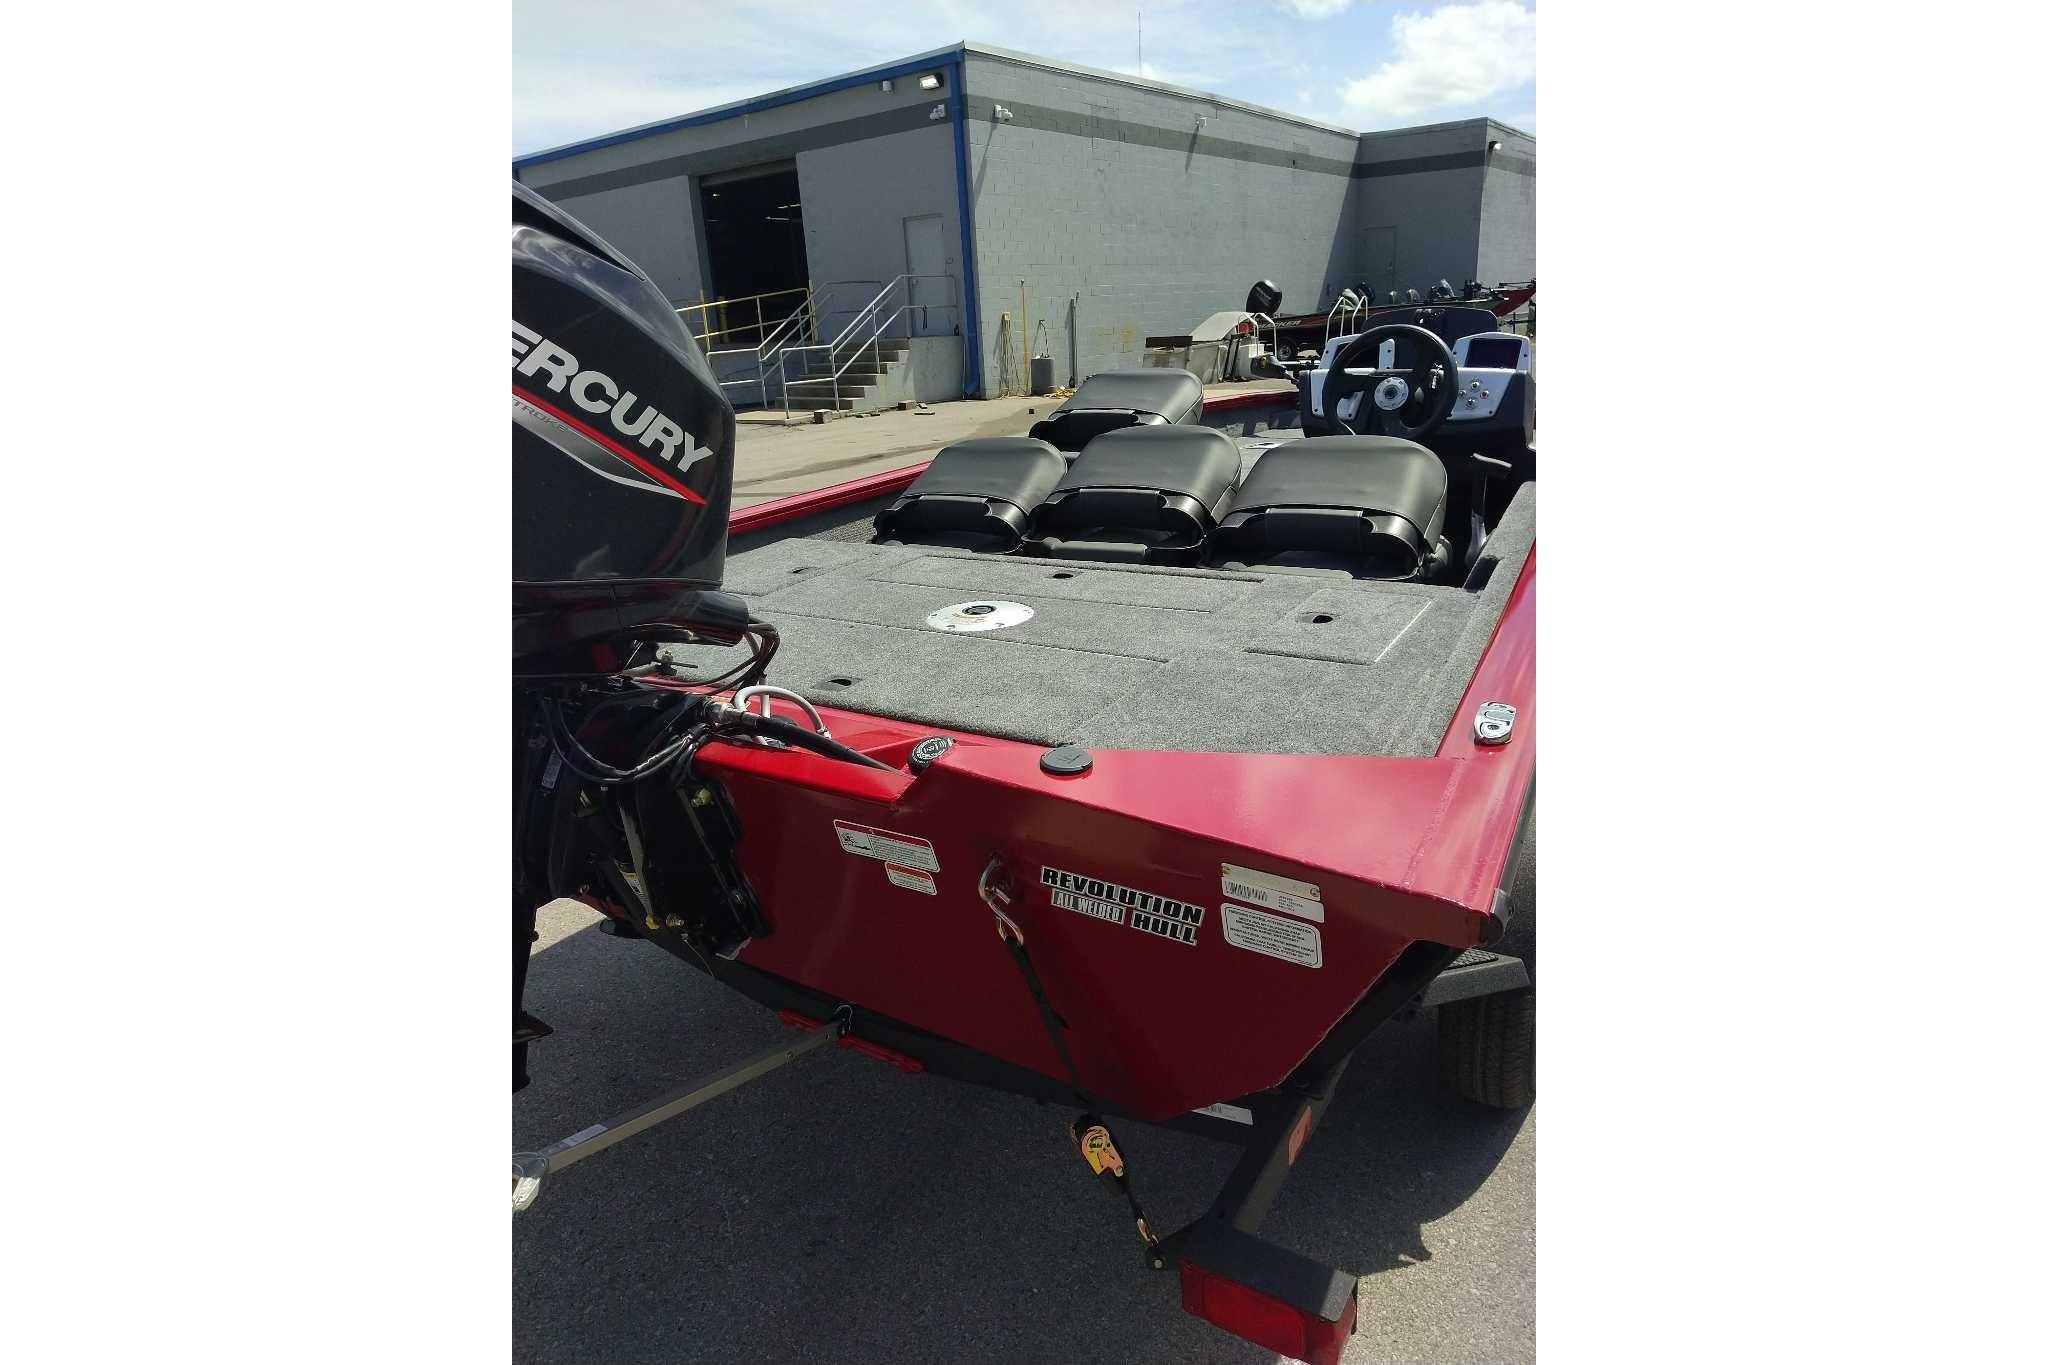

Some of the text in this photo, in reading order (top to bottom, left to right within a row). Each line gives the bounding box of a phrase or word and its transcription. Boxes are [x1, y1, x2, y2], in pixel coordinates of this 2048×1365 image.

[1042, 867, 1202, 925] REVOLUTION
[1077, 896, 1121, 922] WELDED
[1133, 910, 1197, 944] HULL
